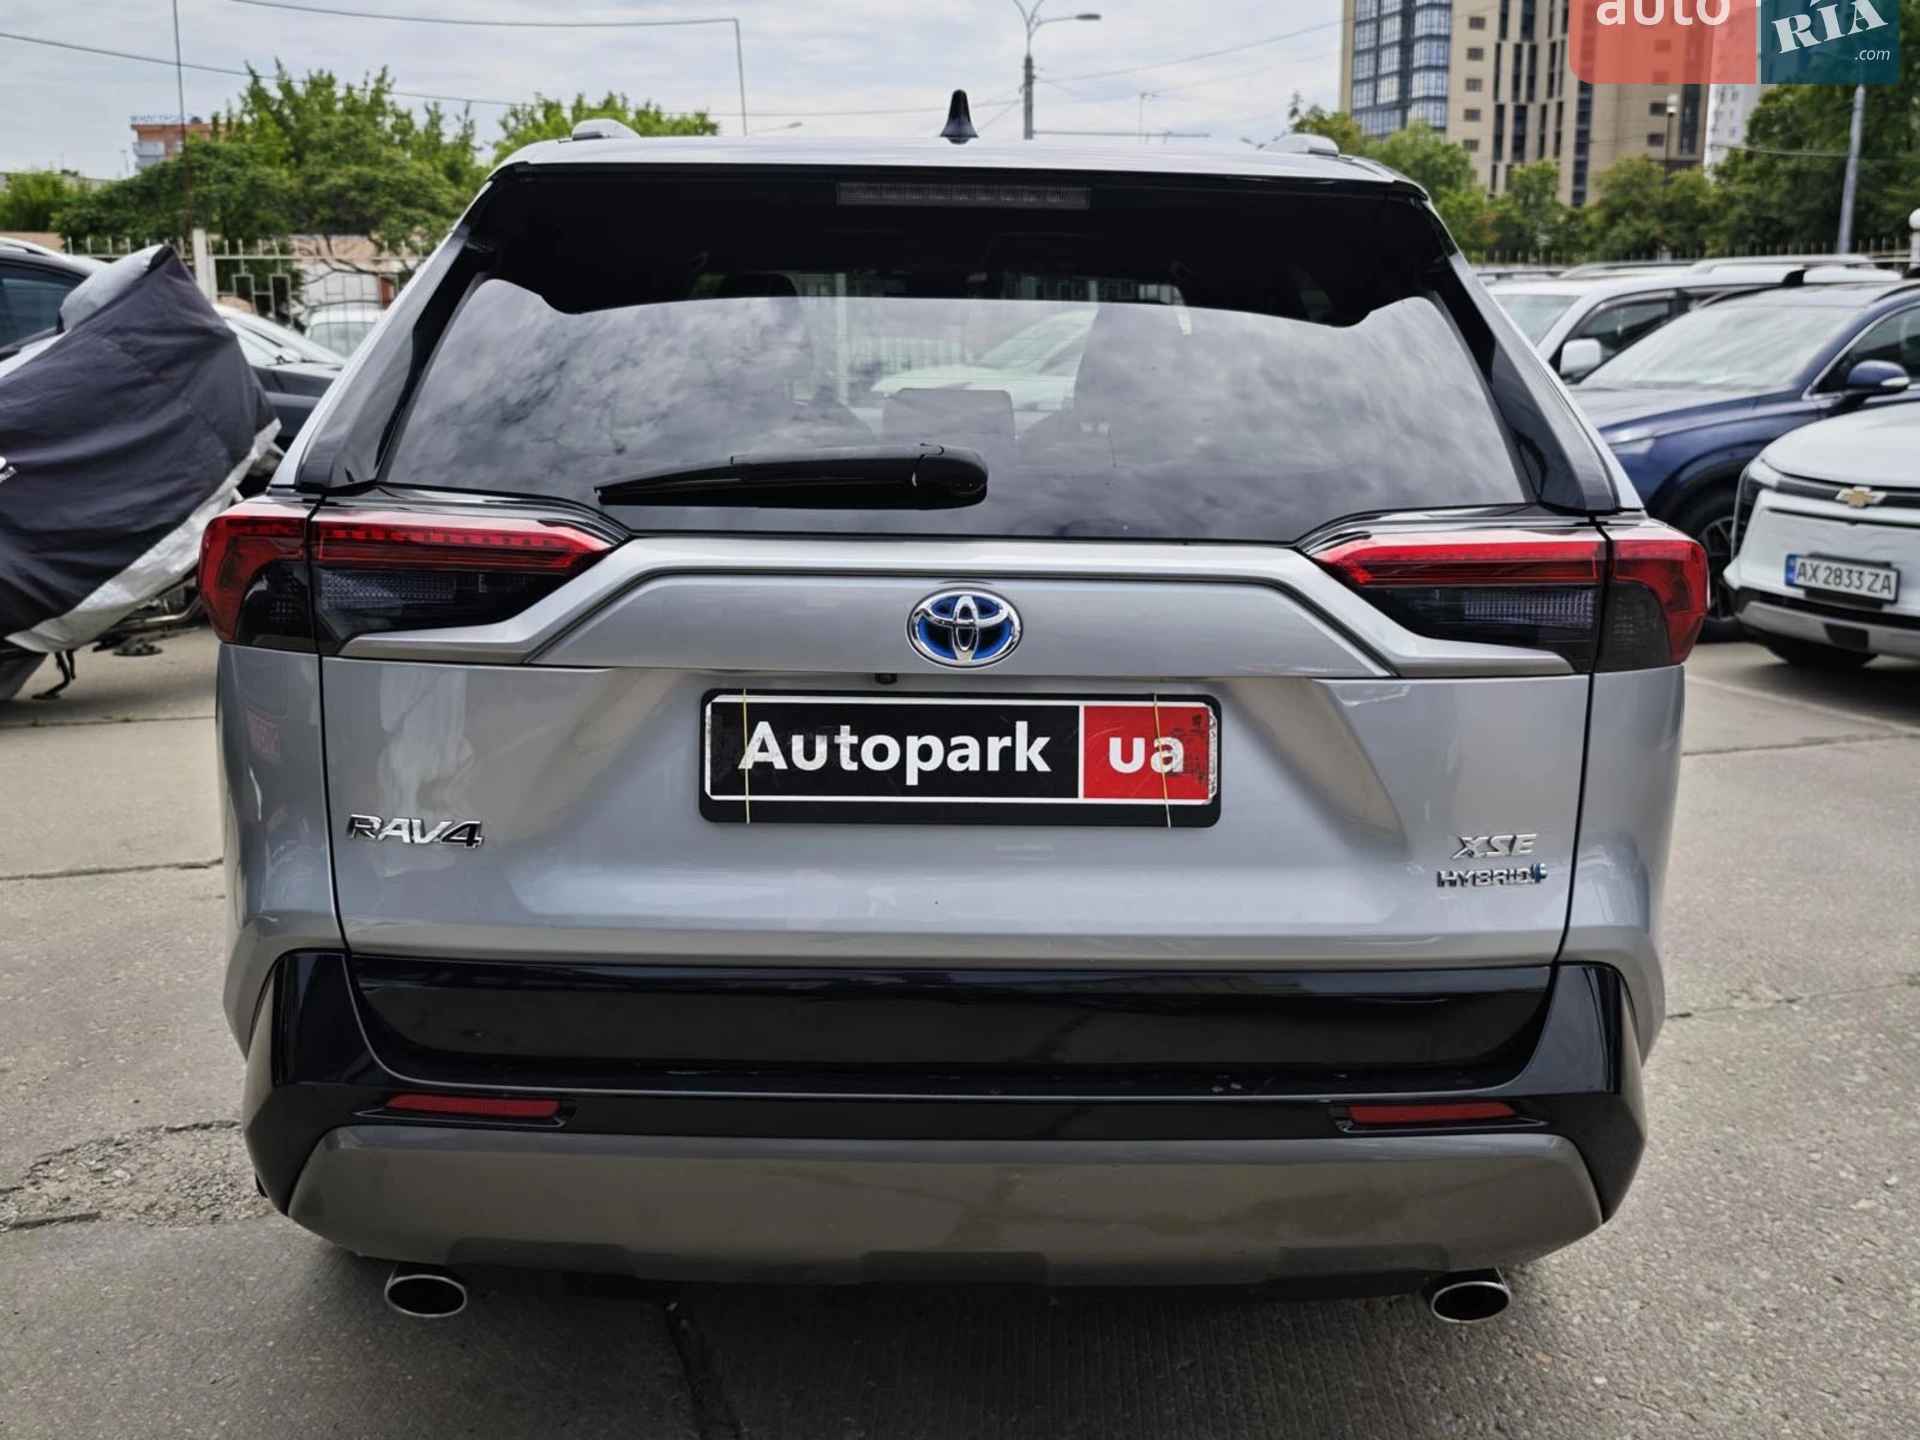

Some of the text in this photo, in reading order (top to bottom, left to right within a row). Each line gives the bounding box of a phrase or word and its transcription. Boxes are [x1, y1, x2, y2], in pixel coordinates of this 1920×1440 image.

[1796, 562, 1892, 595] AX 2833 ZA
[738, 720, 1184, 786] Autopark ua
[347, 813, 484, 849] RAV4
[1450, 833, 1537, 860] XSE
[1437, 868, 1532, 888] HYBRID
